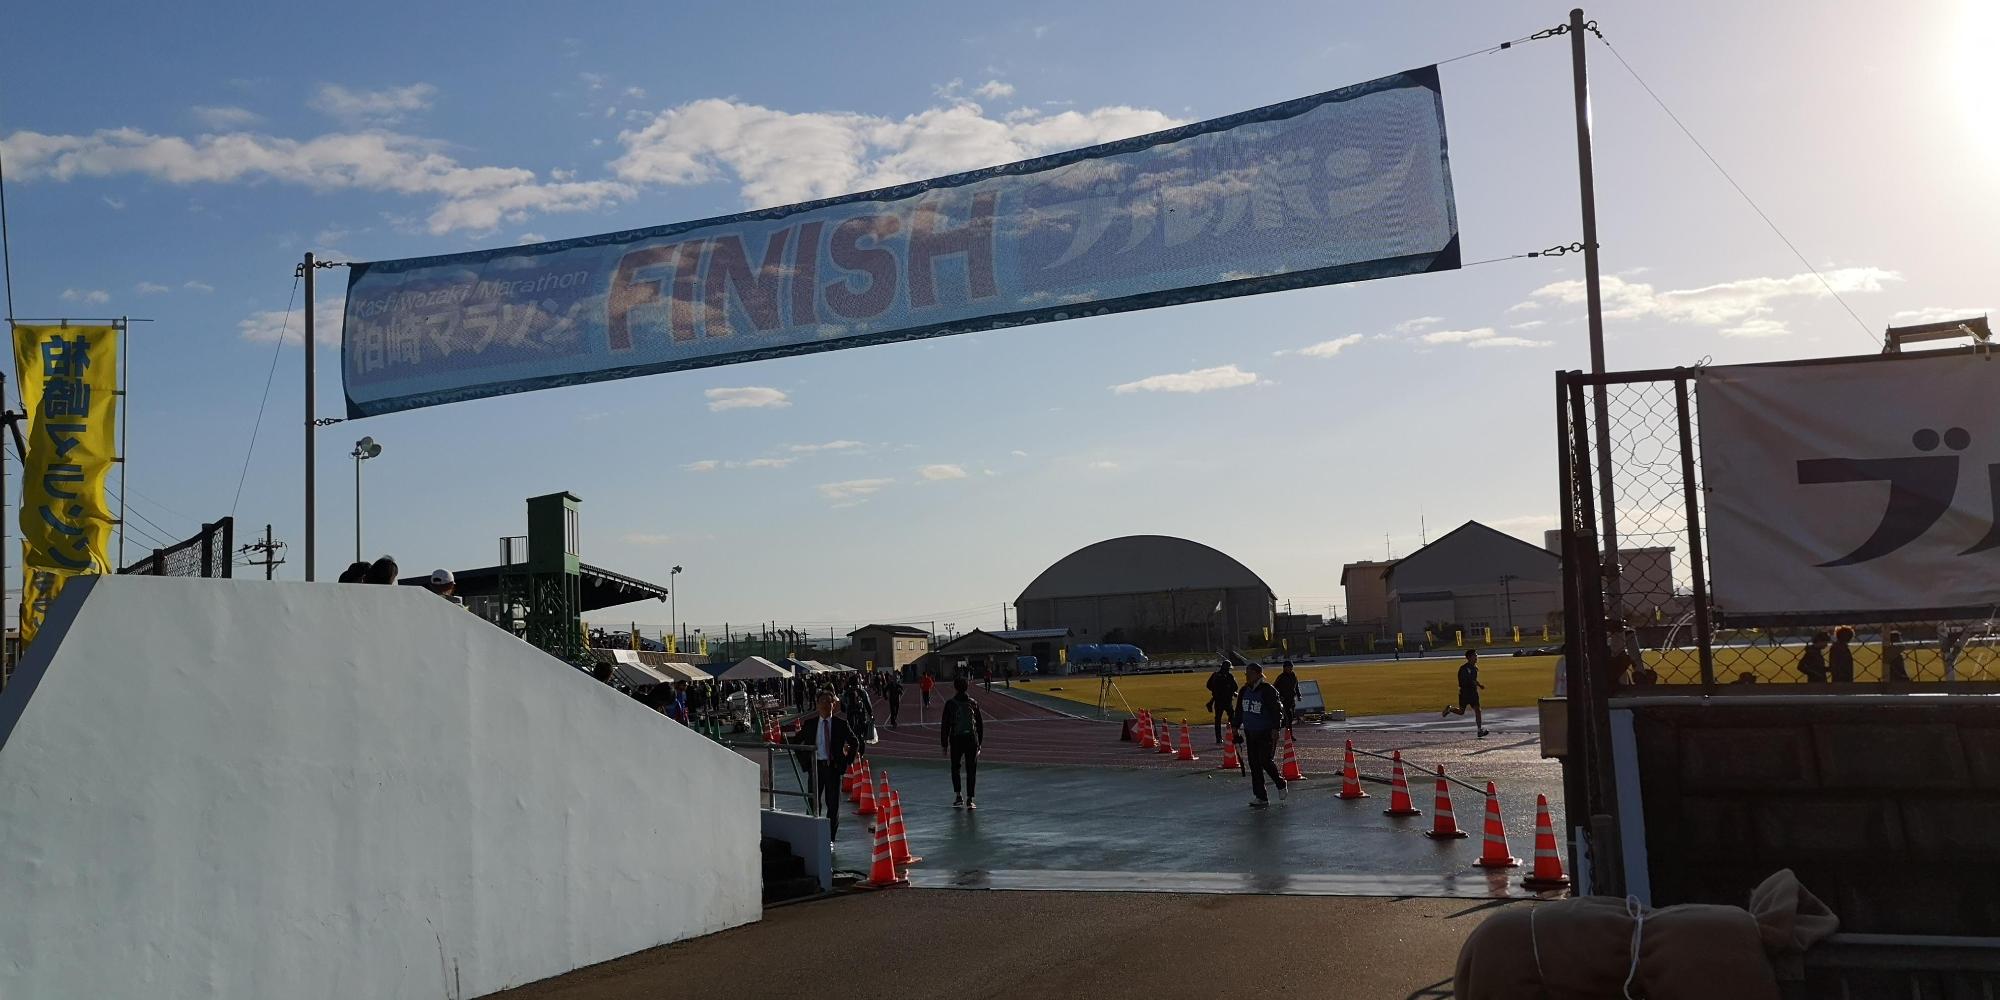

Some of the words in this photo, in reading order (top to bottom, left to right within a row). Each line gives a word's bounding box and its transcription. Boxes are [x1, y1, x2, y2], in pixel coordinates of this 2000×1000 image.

[608, 189, 999, 351] FINISH
[1022, 143, 1417, 271] ブルボン
[353, 303, 583, 375] 柏崎マラソン
[355, 285, 472, 318] Kashiwazaki
[477, 271, 588, 299] Marathon
[1796, 426, 2000, 568] ブ
